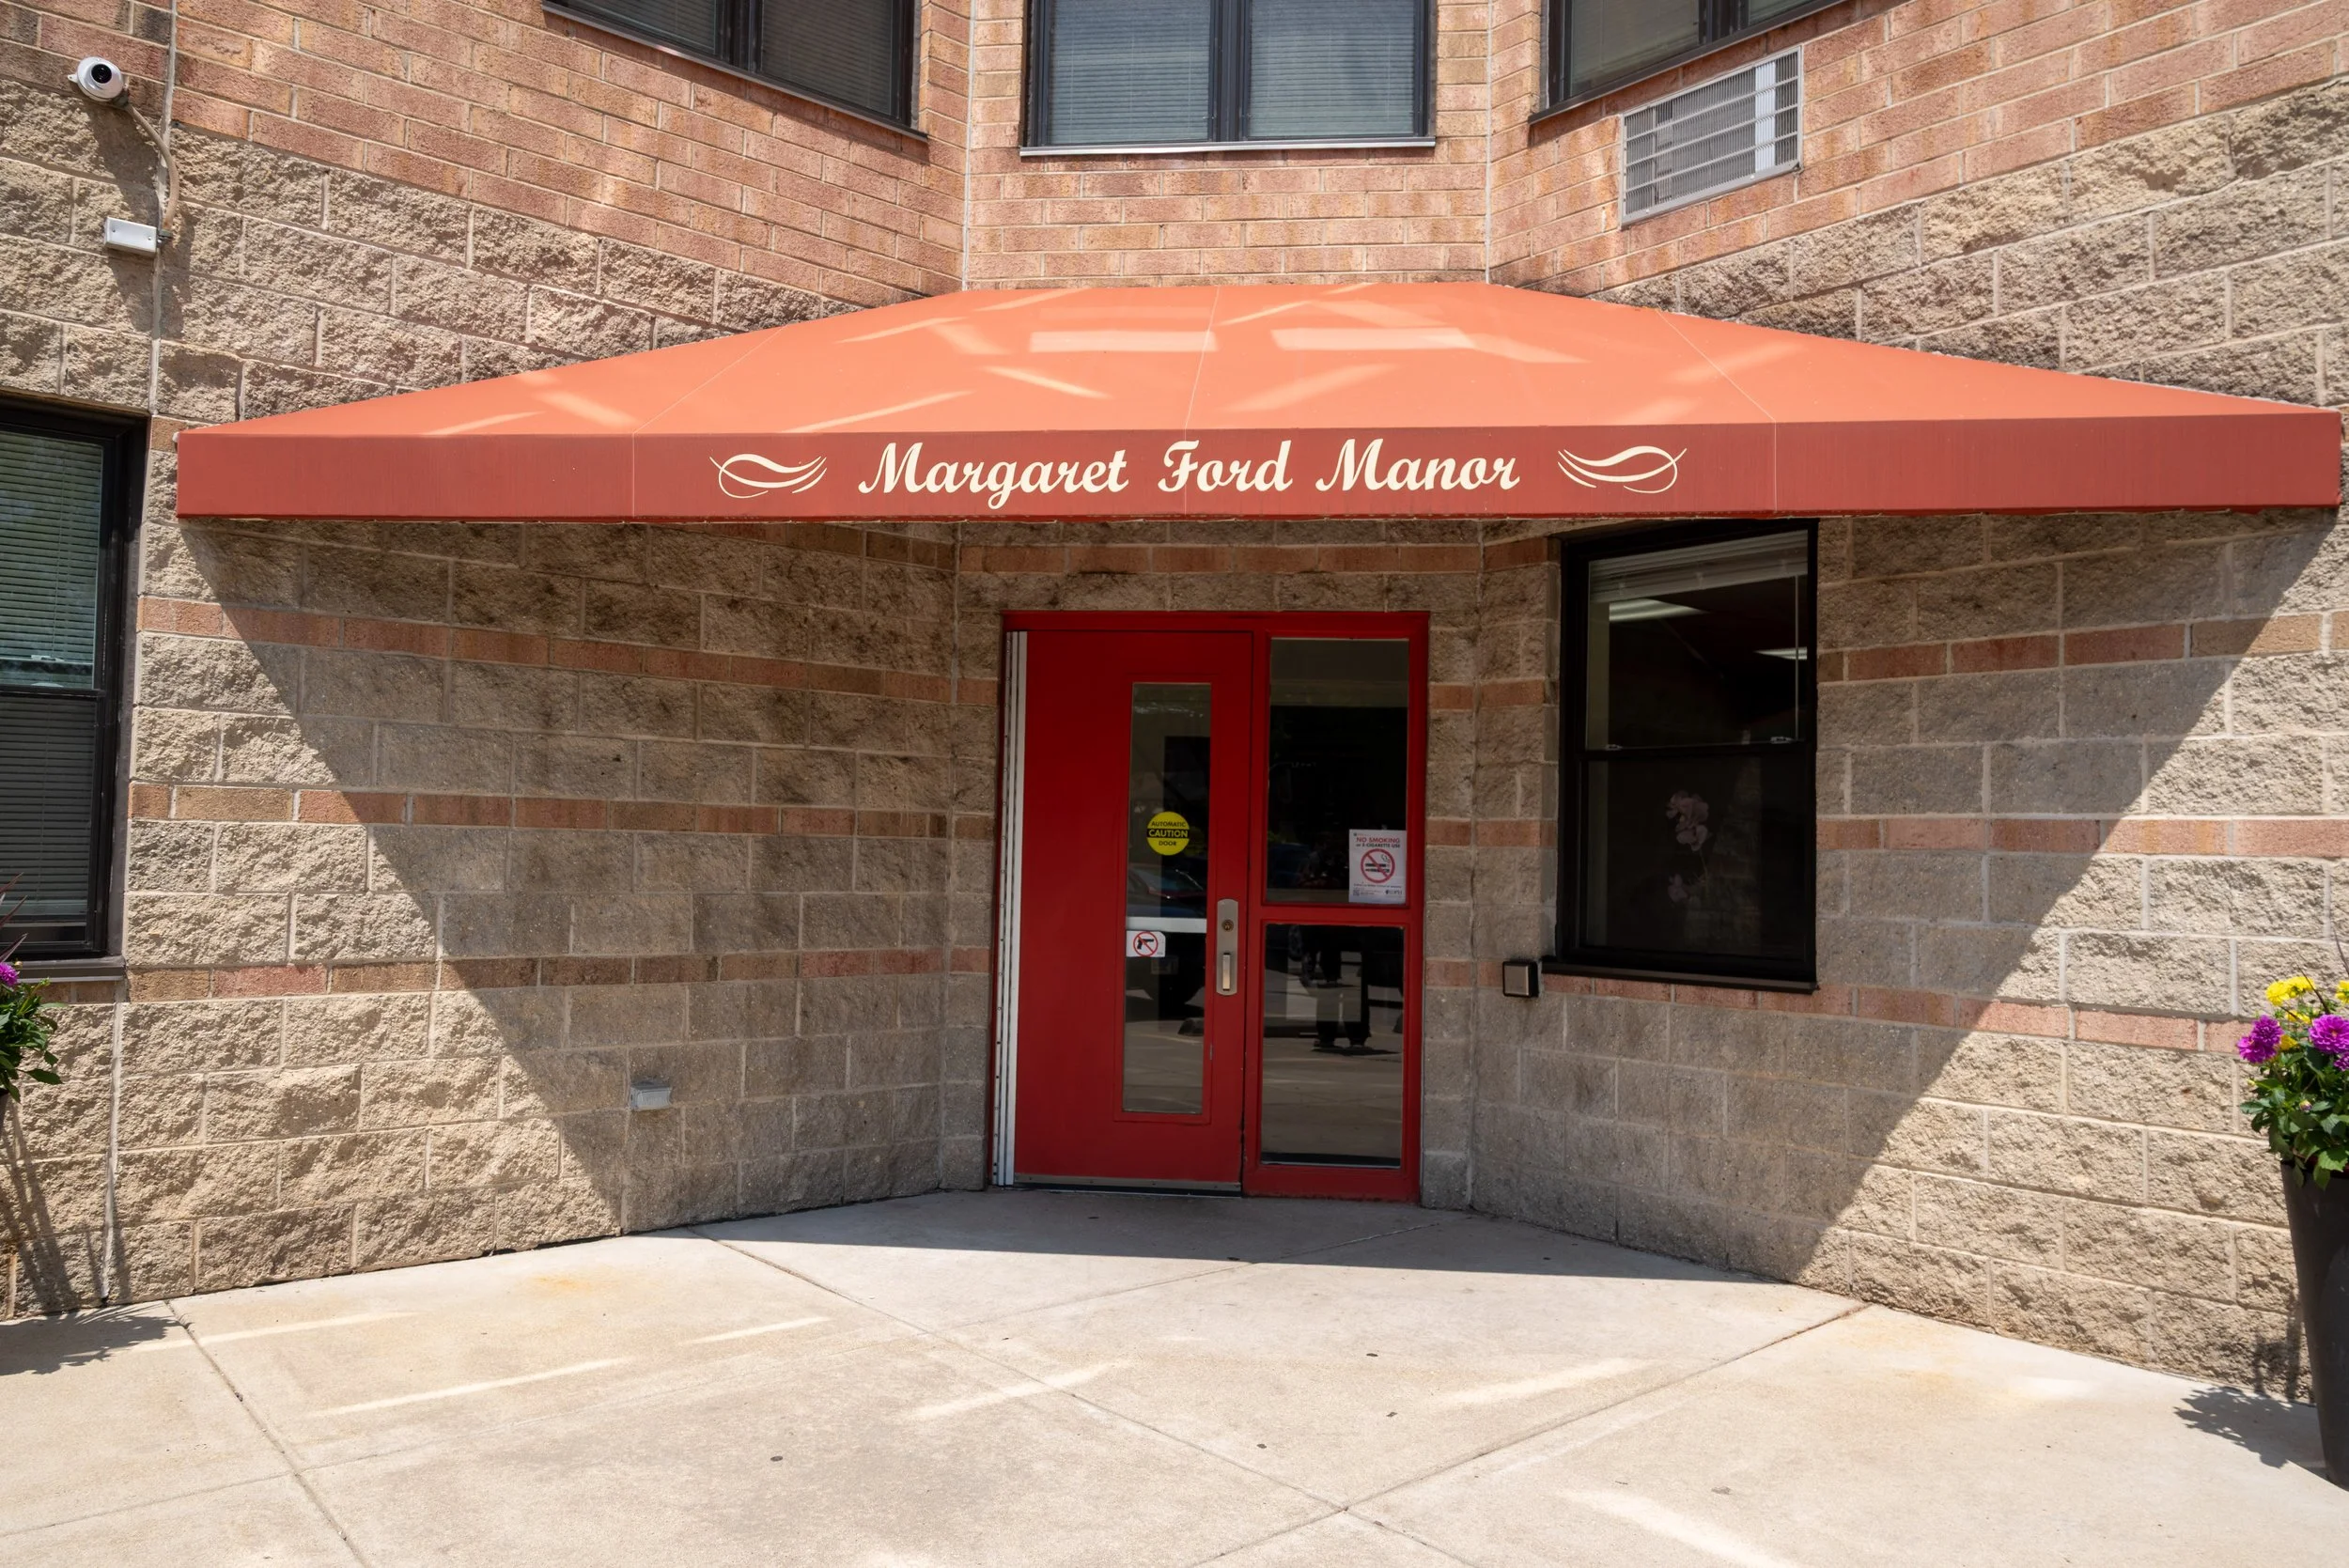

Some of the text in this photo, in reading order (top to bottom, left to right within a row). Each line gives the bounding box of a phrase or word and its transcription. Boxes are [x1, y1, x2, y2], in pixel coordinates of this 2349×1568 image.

[858, 438, 1520, 510] Margaret Ford Manor
[1148, 829, 1189, 837] CAUTION
